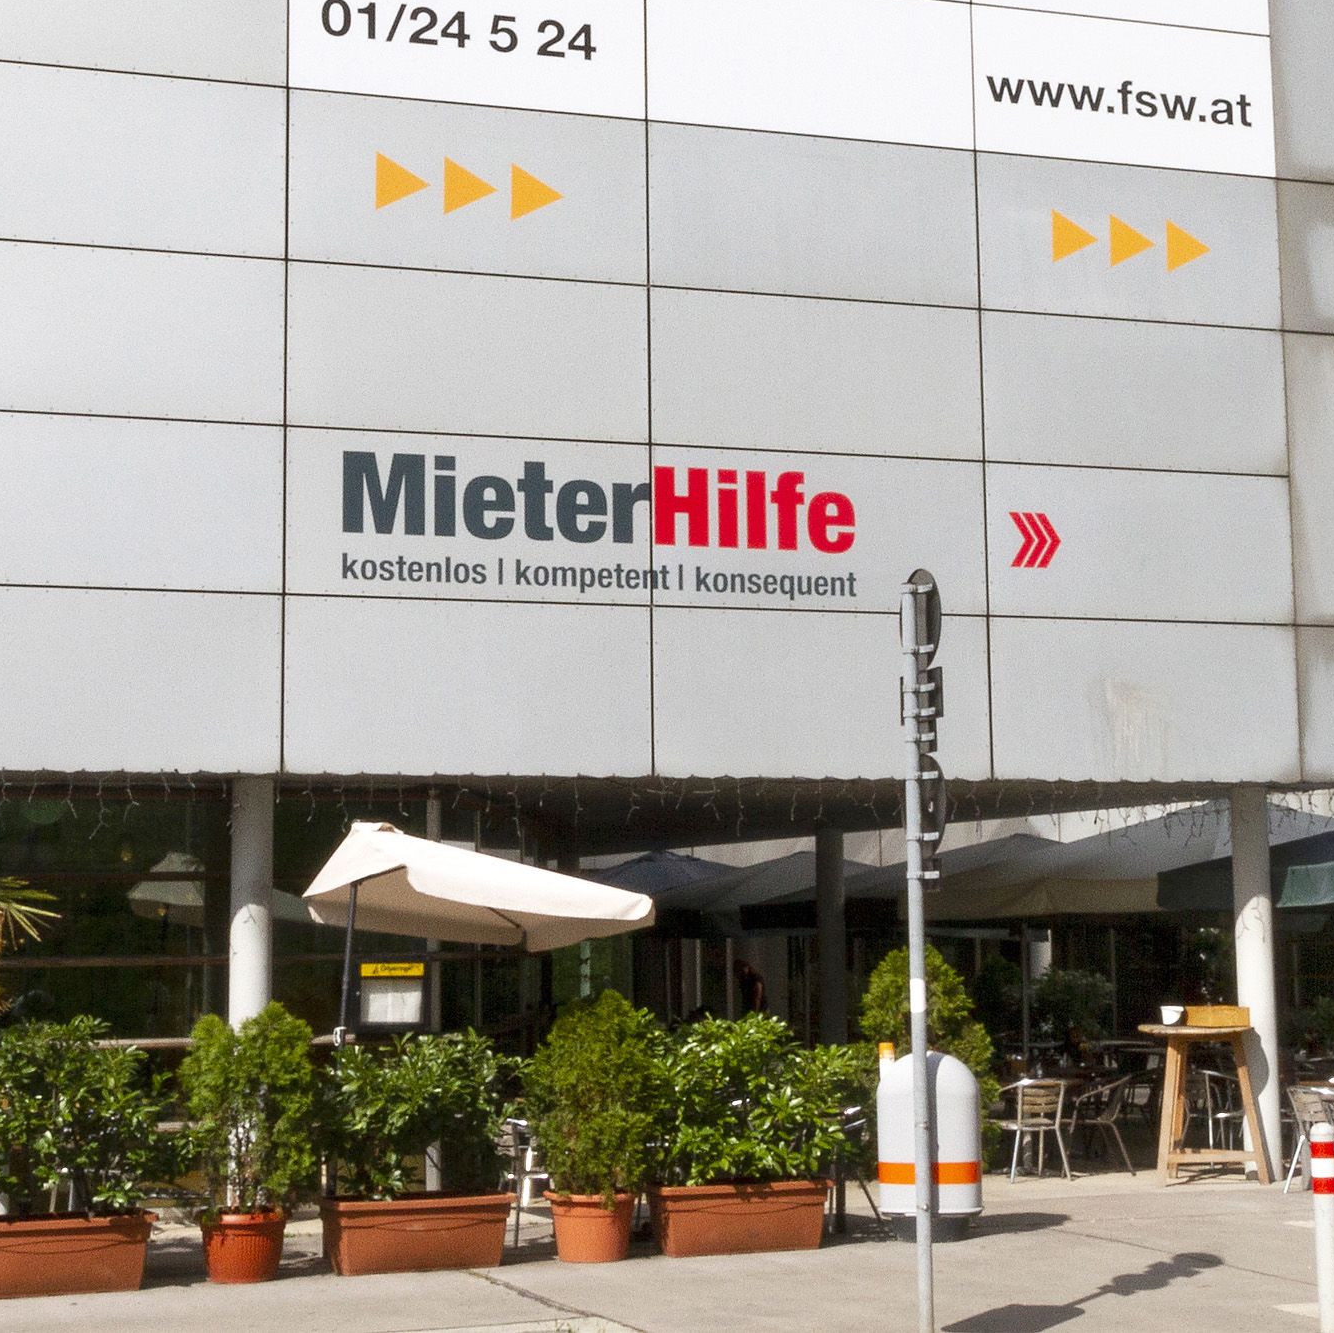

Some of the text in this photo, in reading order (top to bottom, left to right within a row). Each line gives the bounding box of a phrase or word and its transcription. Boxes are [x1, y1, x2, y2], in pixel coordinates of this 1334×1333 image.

[489, 14, 518, 54] 5
[536, 19, 597, 61] 24
[986, 75, 1253, 128] www.fsw.at
[342, 450, 857, 555] MieterHilfe
[342, 552, 487, 585] kostenlos
[515, 558, 671, 594] kompetent
[695, 565, 857, 601] konsequent
